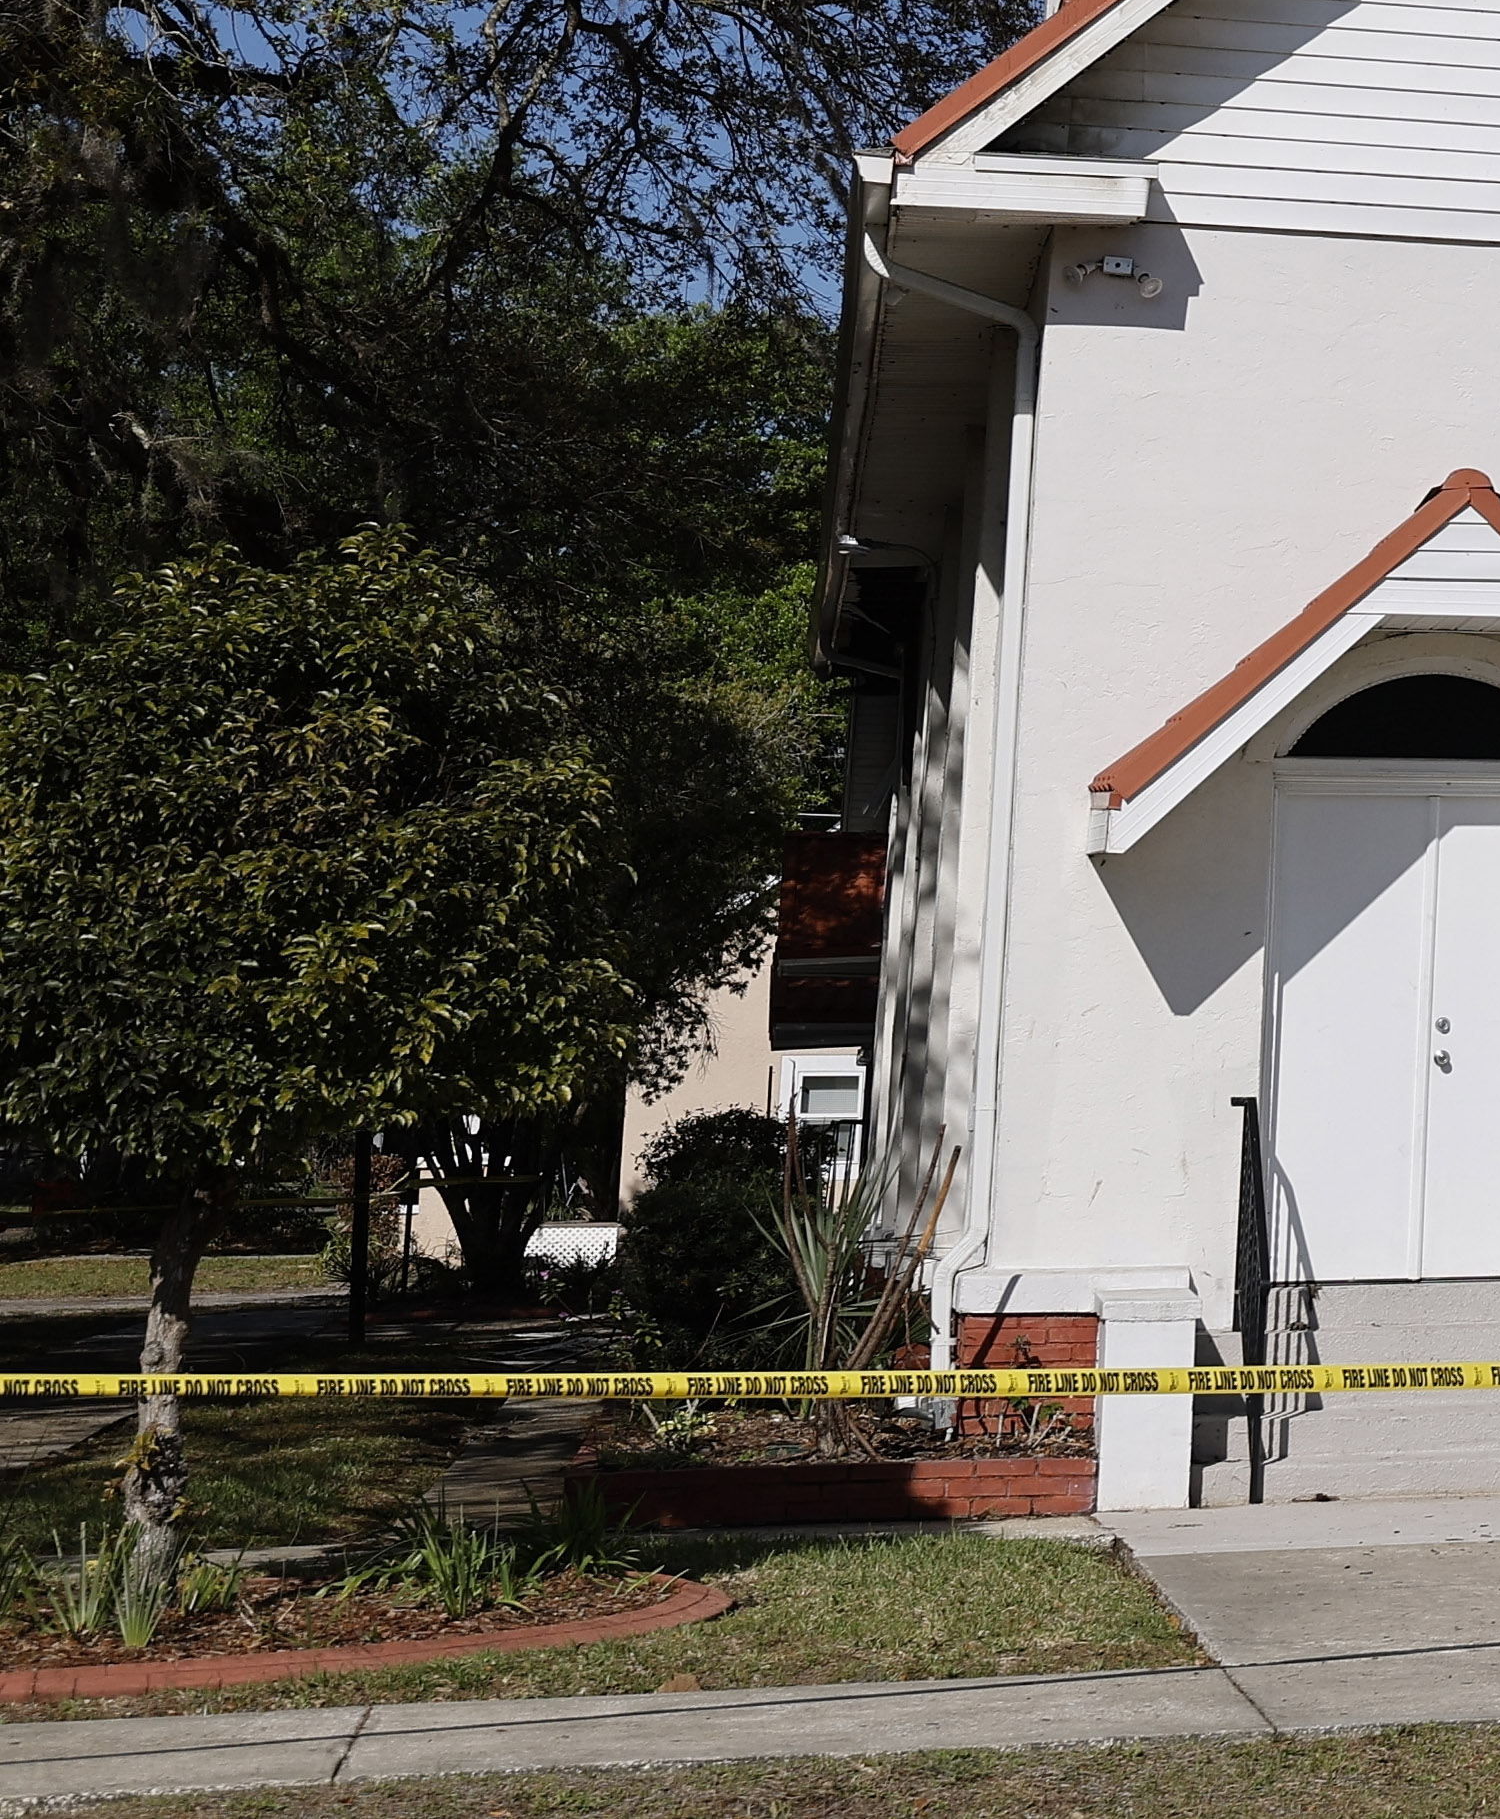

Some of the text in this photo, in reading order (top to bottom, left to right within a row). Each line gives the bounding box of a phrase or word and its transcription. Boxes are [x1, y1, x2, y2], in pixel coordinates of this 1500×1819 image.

[117, 1379, 279, 1397] FIRE LINE DO NOT CROSS
[316, 1379, 471, 1397] FIRE LINE DO NOT CROSS
[505, 1378, 653, 1397] FIRE LINE DO NOT CROSS
[687, 1376, 829, 1397] FIRE LINE DO NOT CROSS
[860, 1374, 997, 1395] FIRE LINE DO NOT CROSS
[1027, 1372, 1159, 1393] FIRE LINE DO NOT CROSS
[1188, 1369, 1314, 1390] FIRE LINE DO NOT CROSS
[1342, 1367, 1464, 1388] FIRE LINE DO NOT CROSS
[2, 1380, 79, 1397] NOT CROSS
